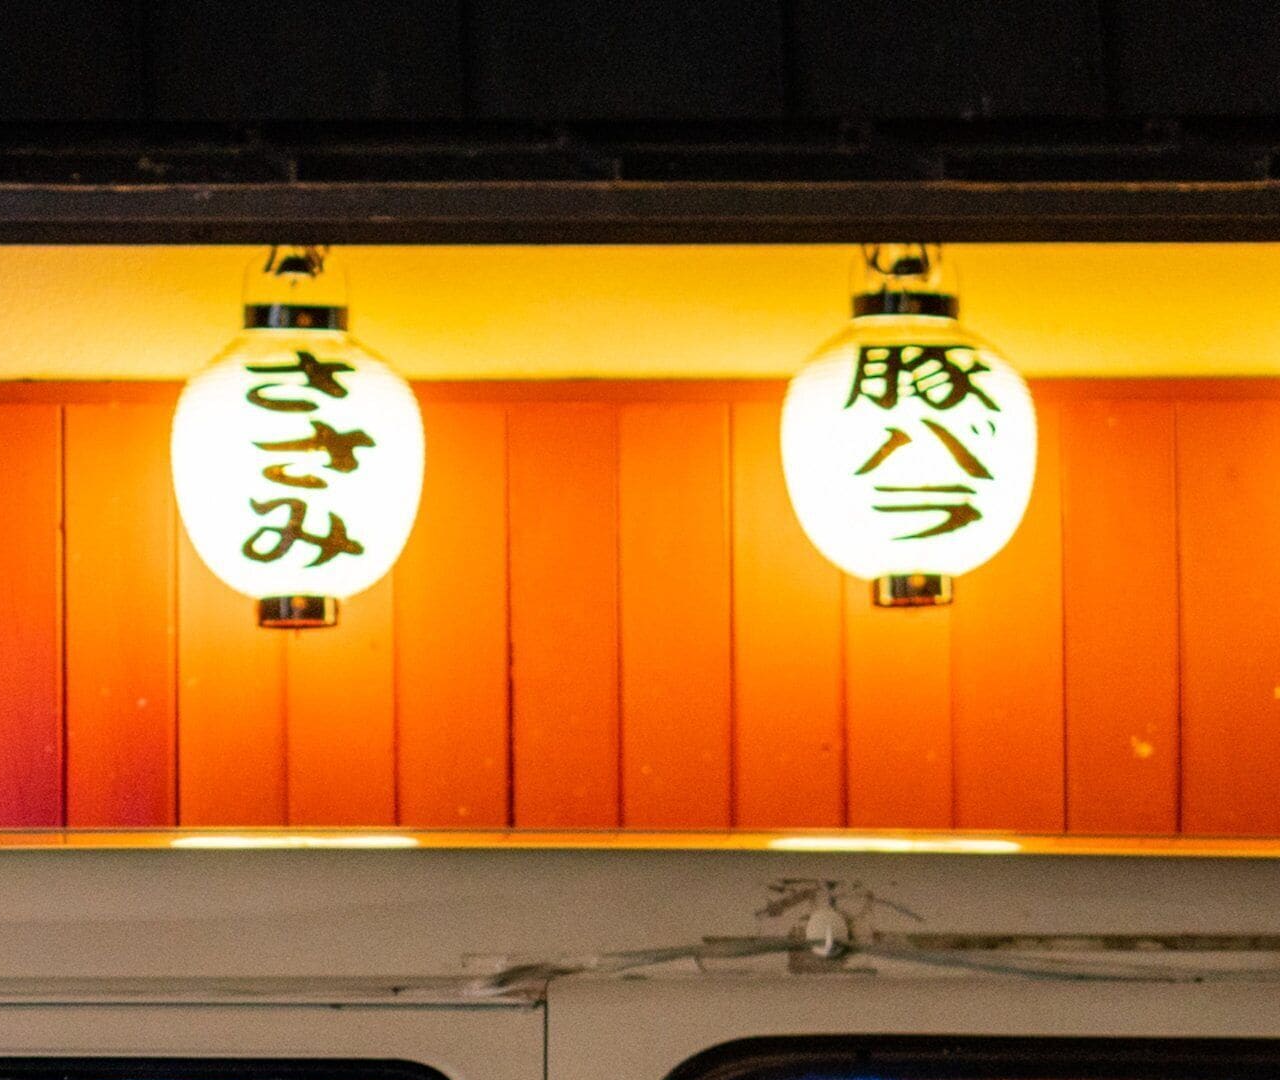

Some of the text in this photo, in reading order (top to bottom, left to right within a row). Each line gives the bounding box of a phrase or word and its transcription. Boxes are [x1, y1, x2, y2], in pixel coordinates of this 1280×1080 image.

[241, 350, 377, 568] ささみ
[843, 343, 1002, 542] 豚バラ
